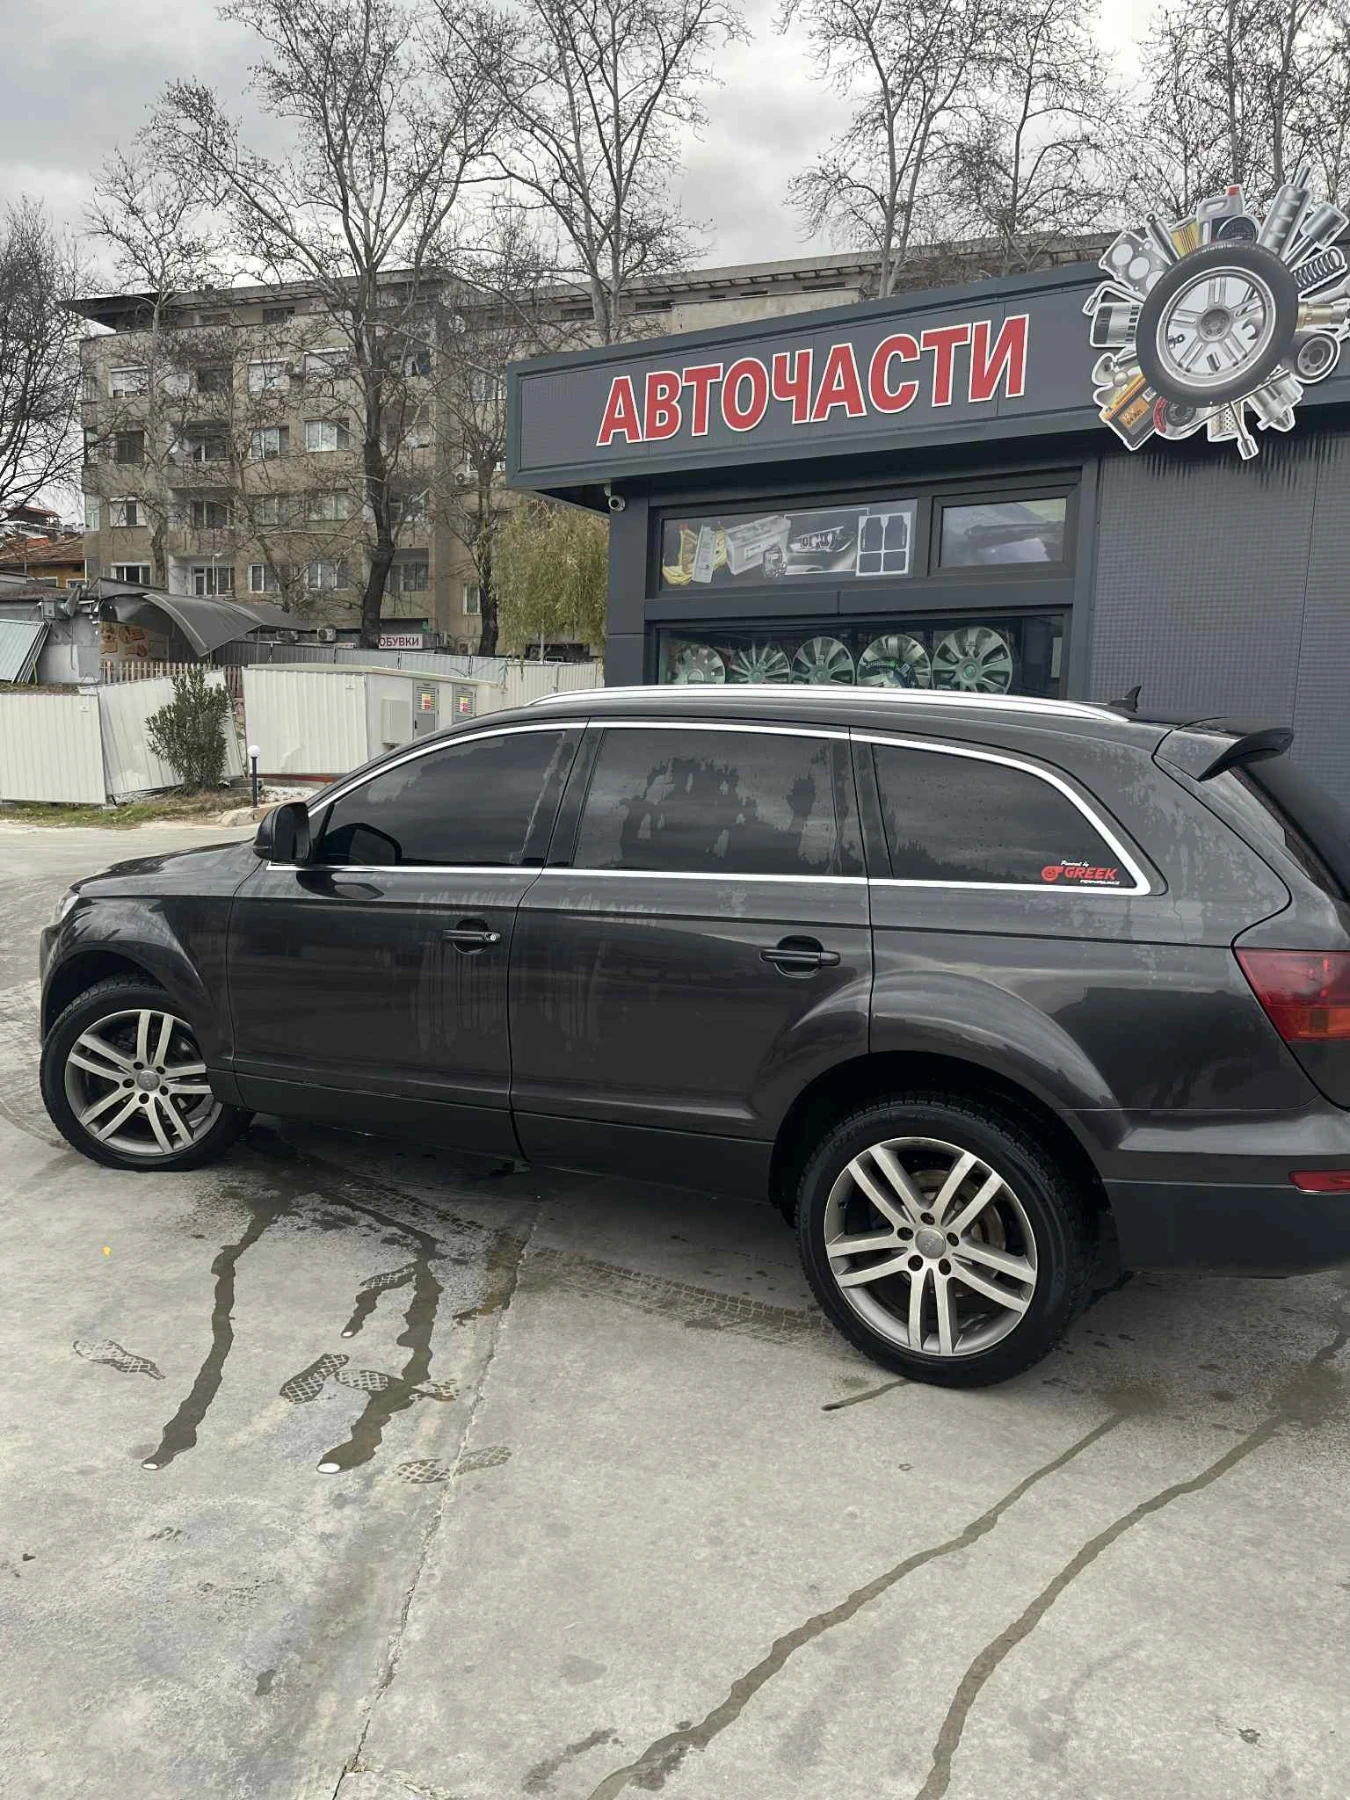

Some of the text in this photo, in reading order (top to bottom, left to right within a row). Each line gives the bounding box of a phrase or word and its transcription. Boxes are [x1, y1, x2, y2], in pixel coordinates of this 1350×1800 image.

[596, 314, 1030, 446] АВТОЧАСТИ
[379, 636, 419, 647] ОБУВКИ
[1064, 866, 1118, 880] GREEK
